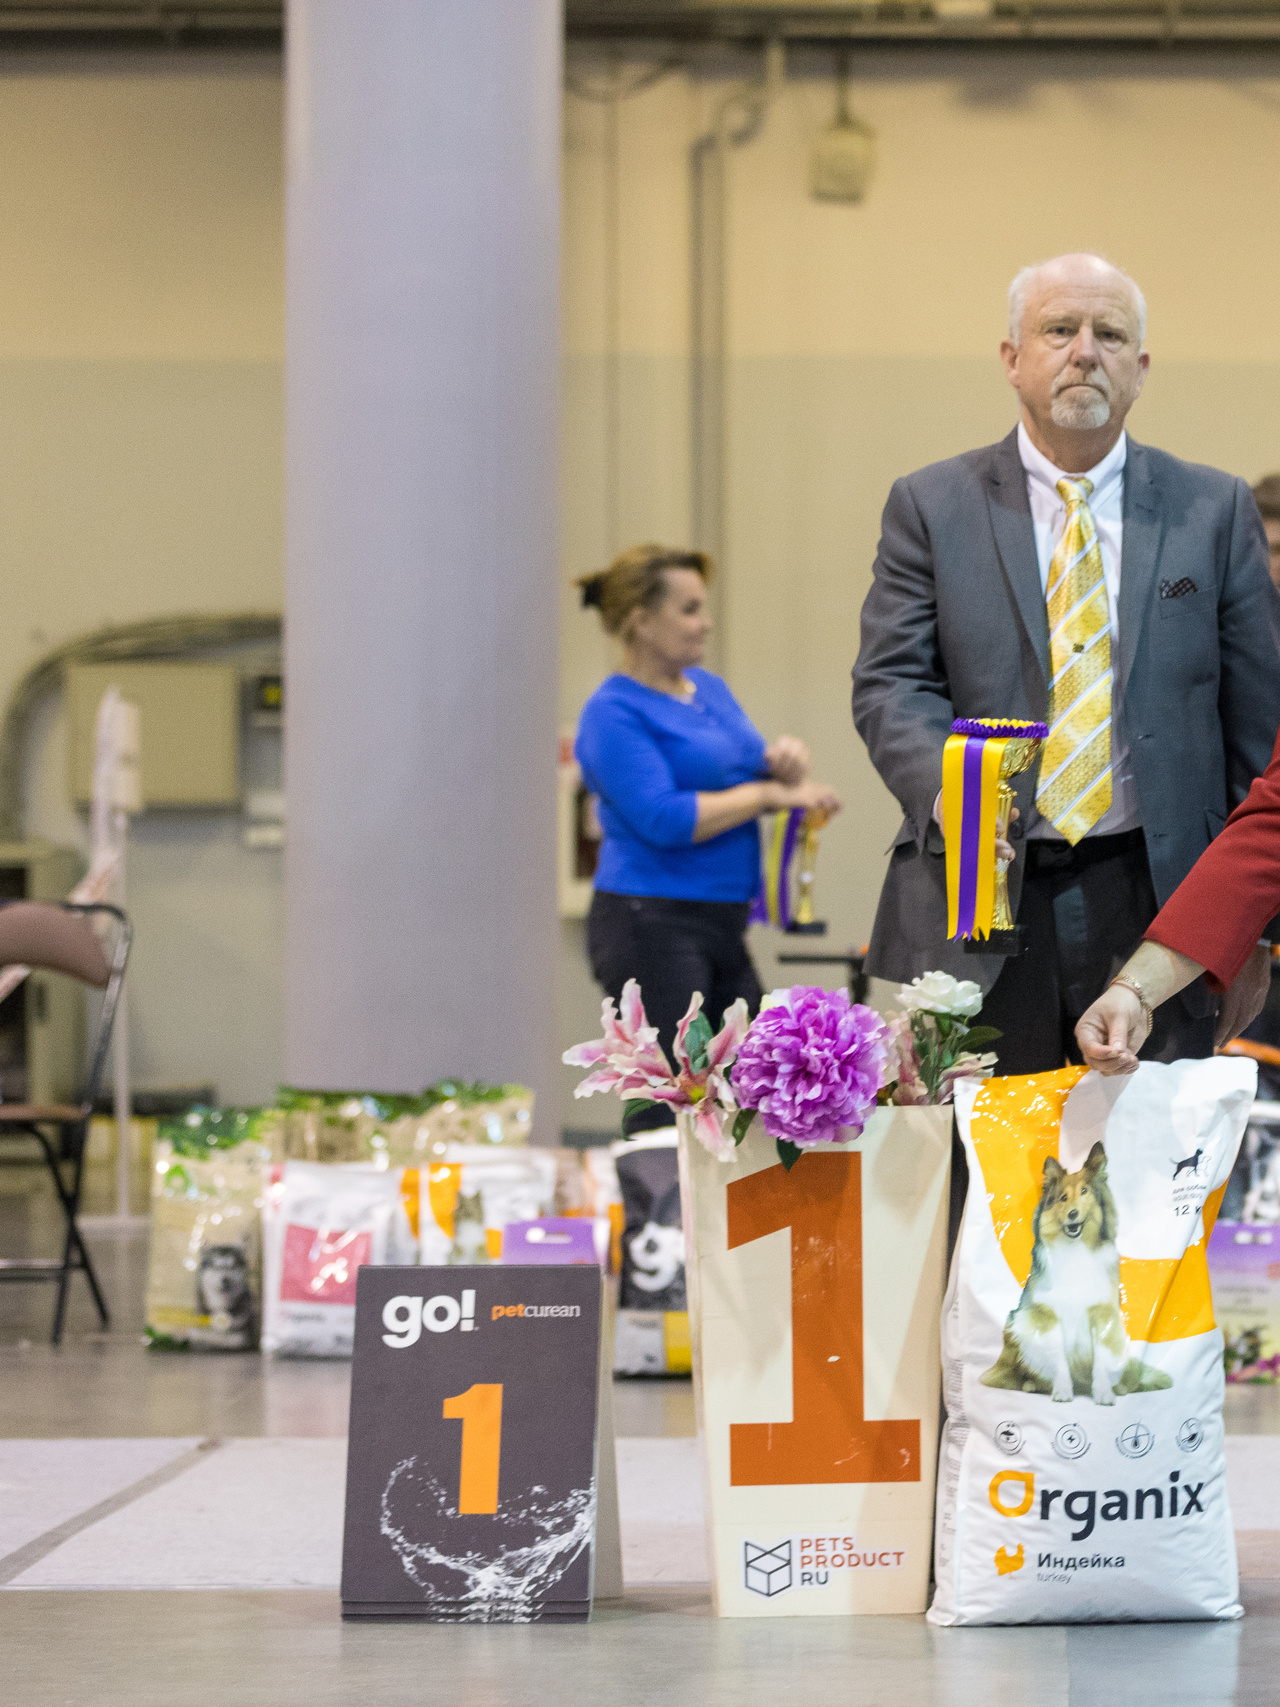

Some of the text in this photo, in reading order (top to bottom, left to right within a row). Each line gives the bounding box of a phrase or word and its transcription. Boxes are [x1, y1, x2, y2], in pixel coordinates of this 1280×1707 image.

[1174, 1204, 1190, 1217] 12
[382, 1289, 581, 1349] go! petcurean
[726, 1150, 922, 1487] 1
[442, 1383, 504, 1515] 1
[988, 1470, 1205, 1542] Organix
[800, 1537, 854, 1552] PETS
[800, 1551, 905, 1569] PRODUCT
[1037, 1552, 1126, 1571] Индейка
[801, 1571, 830, 1586] RU
[1036, 1572, 1073, 1585] turkey
